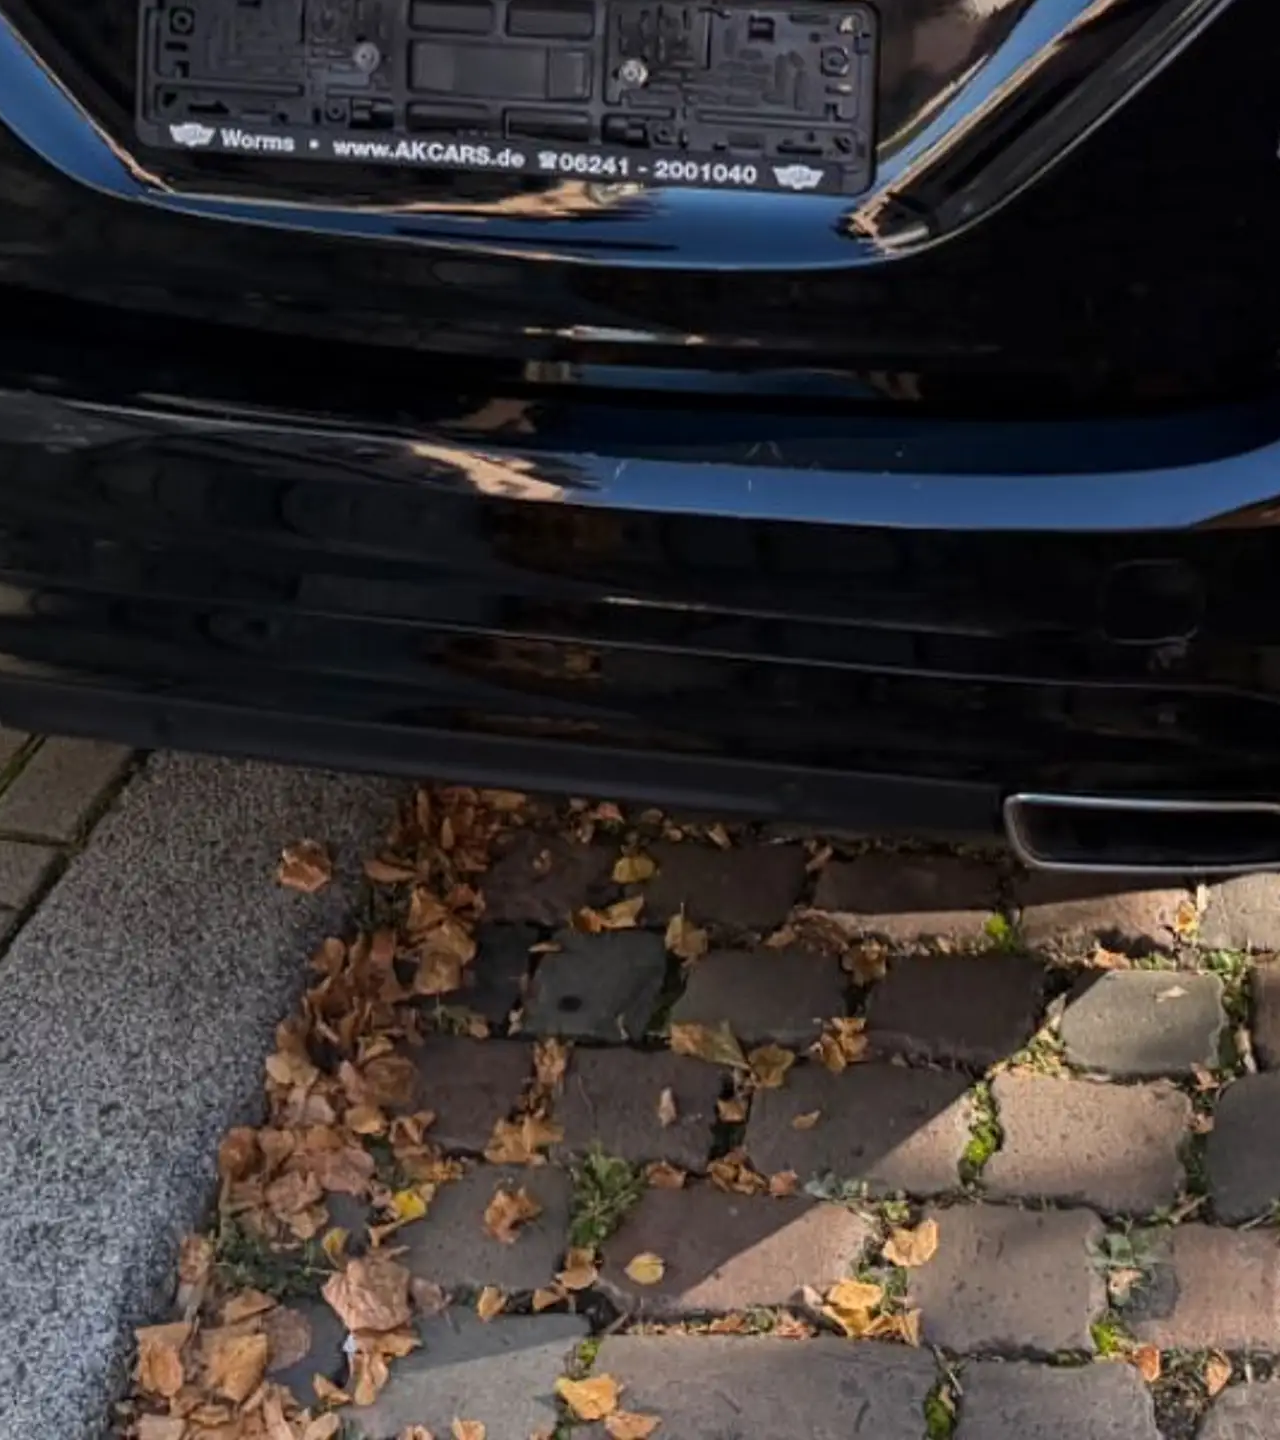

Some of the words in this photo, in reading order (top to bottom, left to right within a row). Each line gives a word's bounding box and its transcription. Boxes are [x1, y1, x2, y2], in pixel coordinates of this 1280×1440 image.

[220, 127, 295, 153] Worms
[333, 138, 525, 169] www.AKCARS.de
[560, 151, 629, 177] 06241
[654, 158, 757, 185] 2001040
